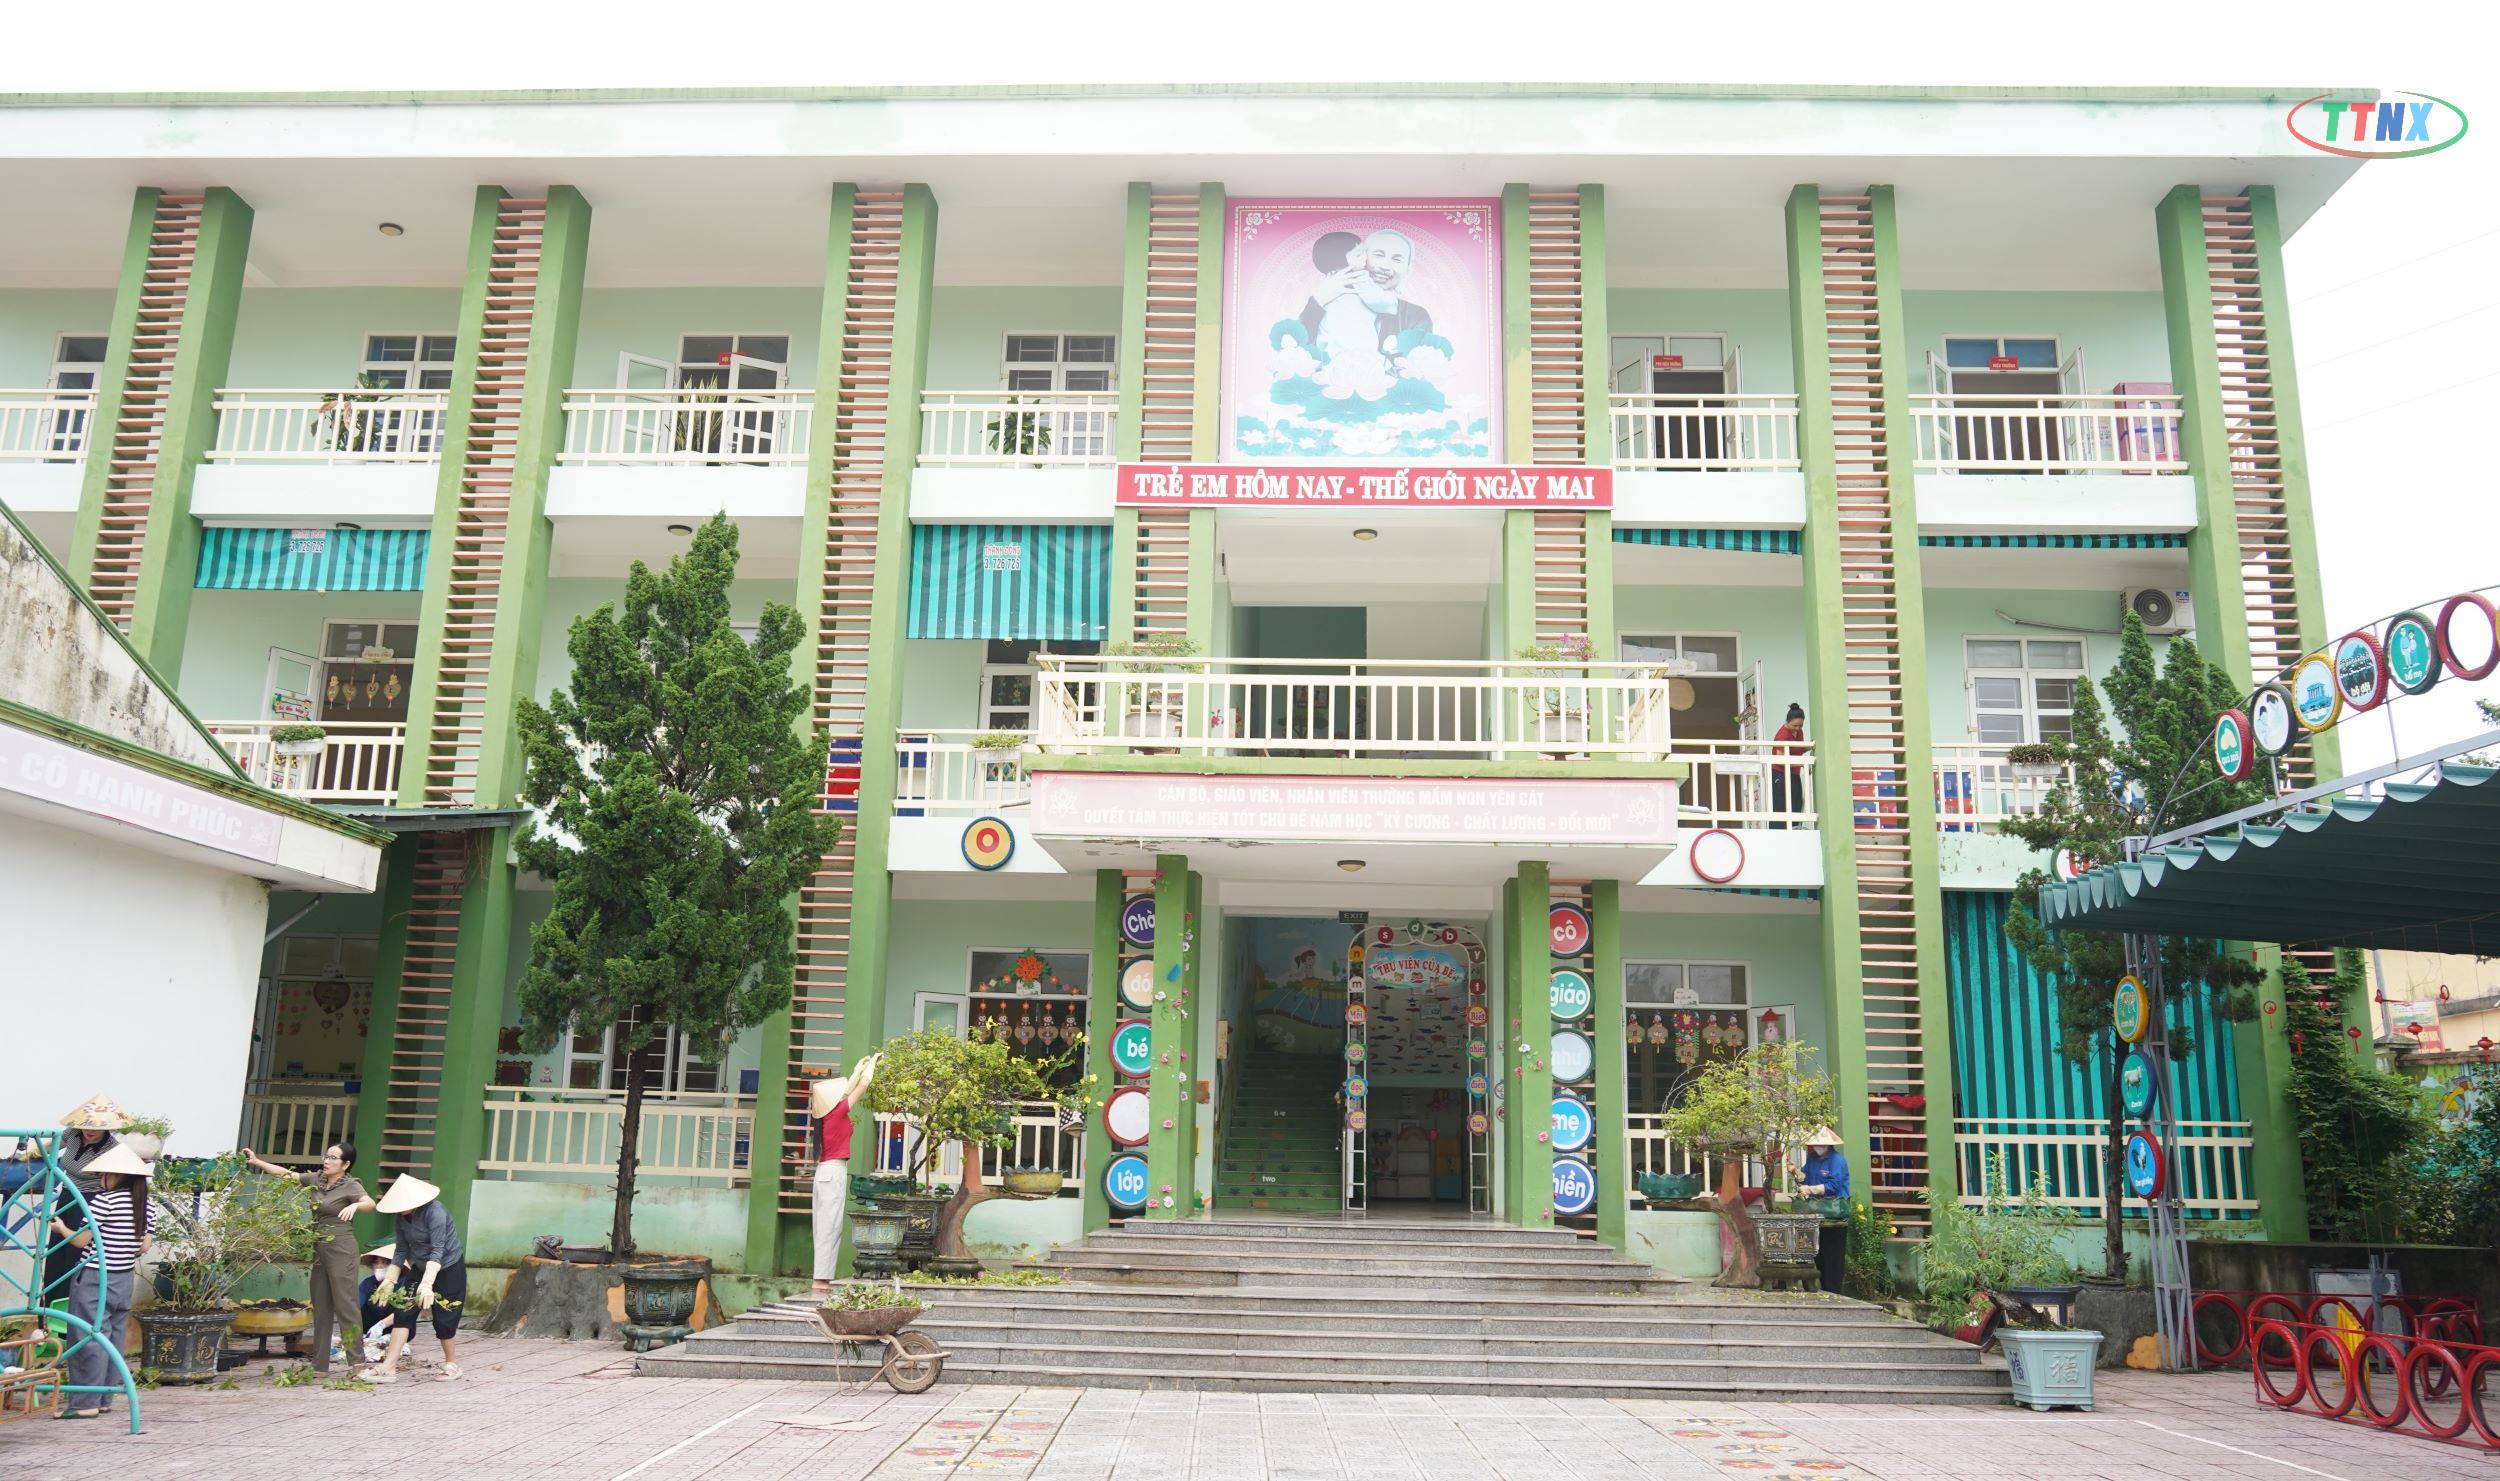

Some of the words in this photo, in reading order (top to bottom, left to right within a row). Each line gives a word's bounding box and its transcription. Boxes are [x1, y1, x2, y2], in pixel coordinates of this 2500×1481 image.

[1134, 465, 1183, 497] TRẺ
[1190, 474, 1228, 498] EM
[1235, 469, 1289, 499] HÔM
[1359, 468, 1408, 499] THẾ
[1414, 470, 1466, 499] GIỚI
[1473, 469, 1539, 499] NGÀY
[1546, 476, 1595, 500] MAI
[20, 751, 68, 789] CÔ
[76, 769, 164, 818] HẠNH
[169, 797, 243, 841] PHÚC
[1158, 784, 1185, 801] CÁN
[1214, 785, 1245, 802] GIÁO
[1287, 786, 1324, 803] NHÂN
[1328, 786, 1358, 804] VIÊN
[1362, 787, 1414, 805] TRƯỜNG
[1419, 785, 1452, 805] MẦM
[1456, 790, 1485, 806] NON
[1489, 789, 1515, 806] YÊN
[1520, 789, 1544, 806] CÁT
[1084, 804, 1124, 825] QUYẾT
[1128, 808, 1156, 825] TÂM
[1160, 809, 1194, 828] THỰC
[1198, 808, 1229, 828] HIỆN
[1232, 808, 1256, 827] TỐT
[1260, 808, 1286, 827] CHỦ
[1290, 808, 1306, 827] ĐỀ
[1346, 812, 1373, 831] HỌC
[1405, 813, 1450, 830] CƯƠNG
[1464, 810, 1498, 831] CHẤT
[1559, 809, 1581, 831] ĐỔI
[1128, 910, 1155, 933] Chà
[1553, 919, 1577, 942] cô
[1447, 932, 1454, 940] b
[1377, 960, 1397, 975] THƯ
[1398, 957, 1420, 973] VIỆN
[1422, 958, 1440, 975] CỦA
[1474, 951, 1481, 959] y
[1131, 972, 1152, 993] đó
[1475, 982, 1480, 992] t
[1550, 982, 1586, 1007] giáo
[1127, 1037, 1148, 1058] bé
[1552, 1113, 1580, 1138] mẹ
[1118, 1169, 1144, 1195] lớp
[1262, 1175, 1276, 1183] two
